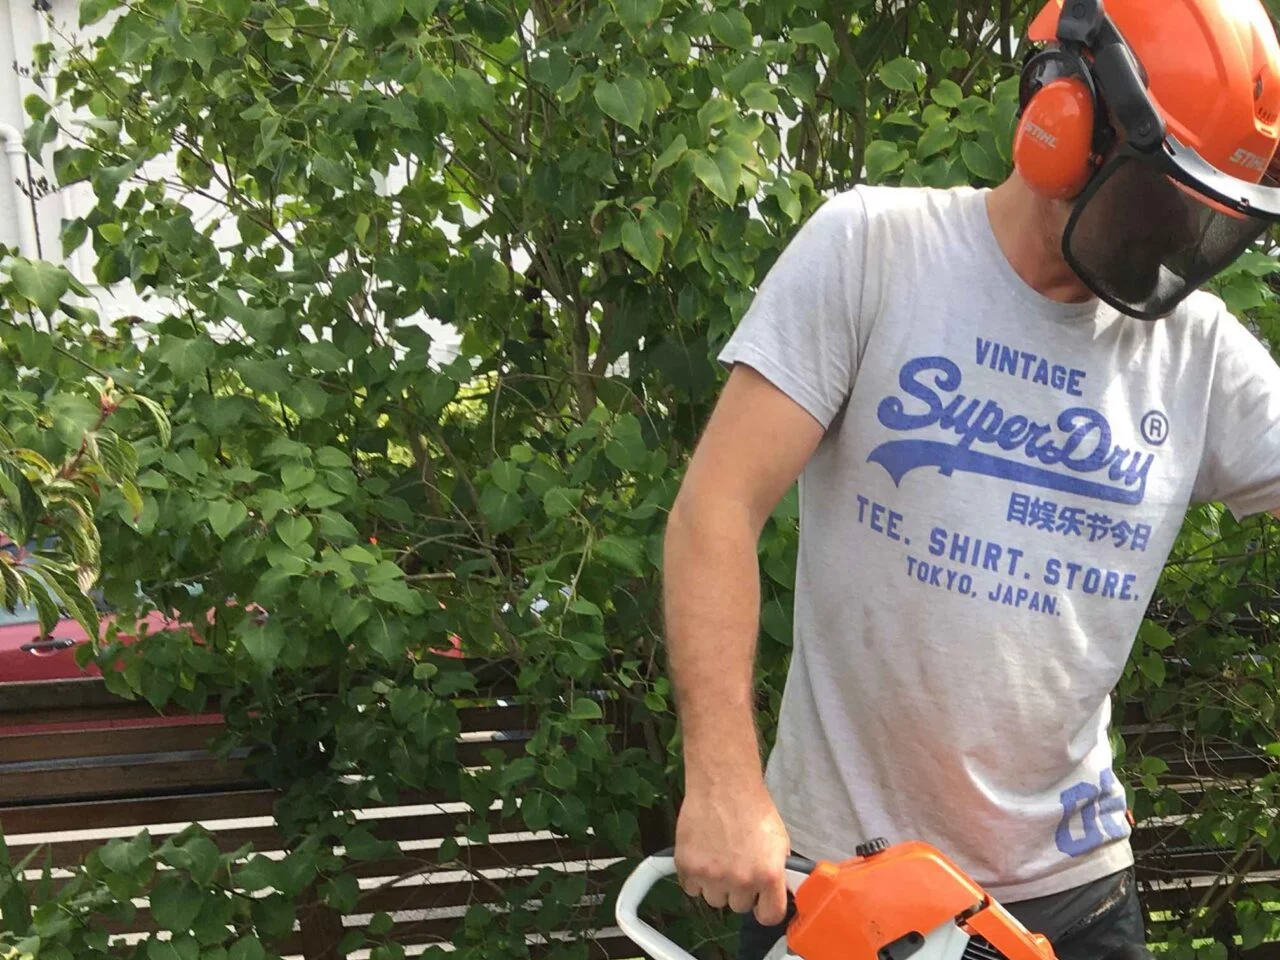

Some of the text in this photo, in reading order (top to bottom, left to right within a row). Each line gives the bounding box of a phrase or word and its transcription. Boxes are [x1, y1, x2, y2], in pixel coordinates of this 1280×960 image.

[976, 337, 1086, 396] VINTAGE
[857, 494, 1139, 601] TEE. SHIRT. STORE.
[906, 555, 1060, 616] TOKYO, JAPAN.
